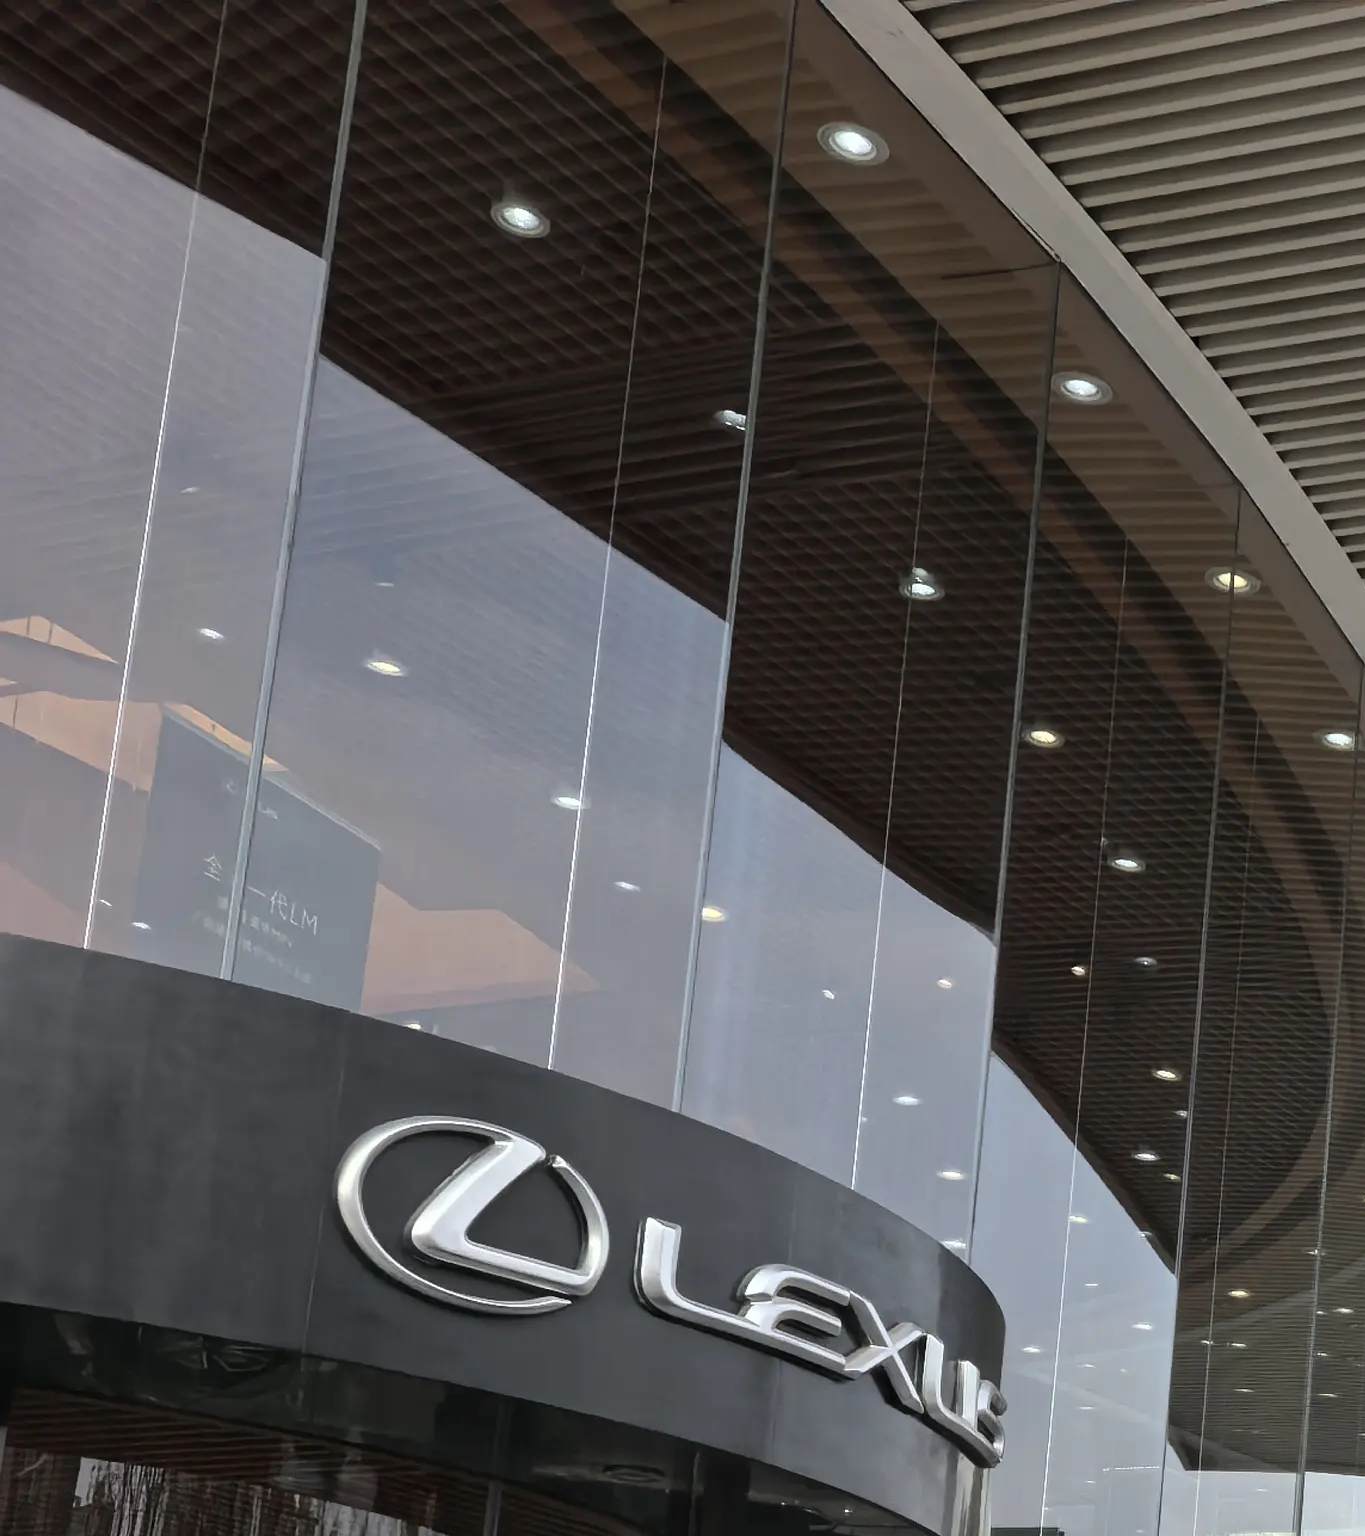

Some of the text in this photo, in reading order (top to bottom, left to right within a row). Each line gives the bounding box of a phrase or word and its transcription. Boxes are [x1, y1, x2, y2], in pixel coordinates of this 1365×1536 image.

[203, 854, 319, 937] 全一代LM
[633, 1216, 1007, 1469] LEXUS
